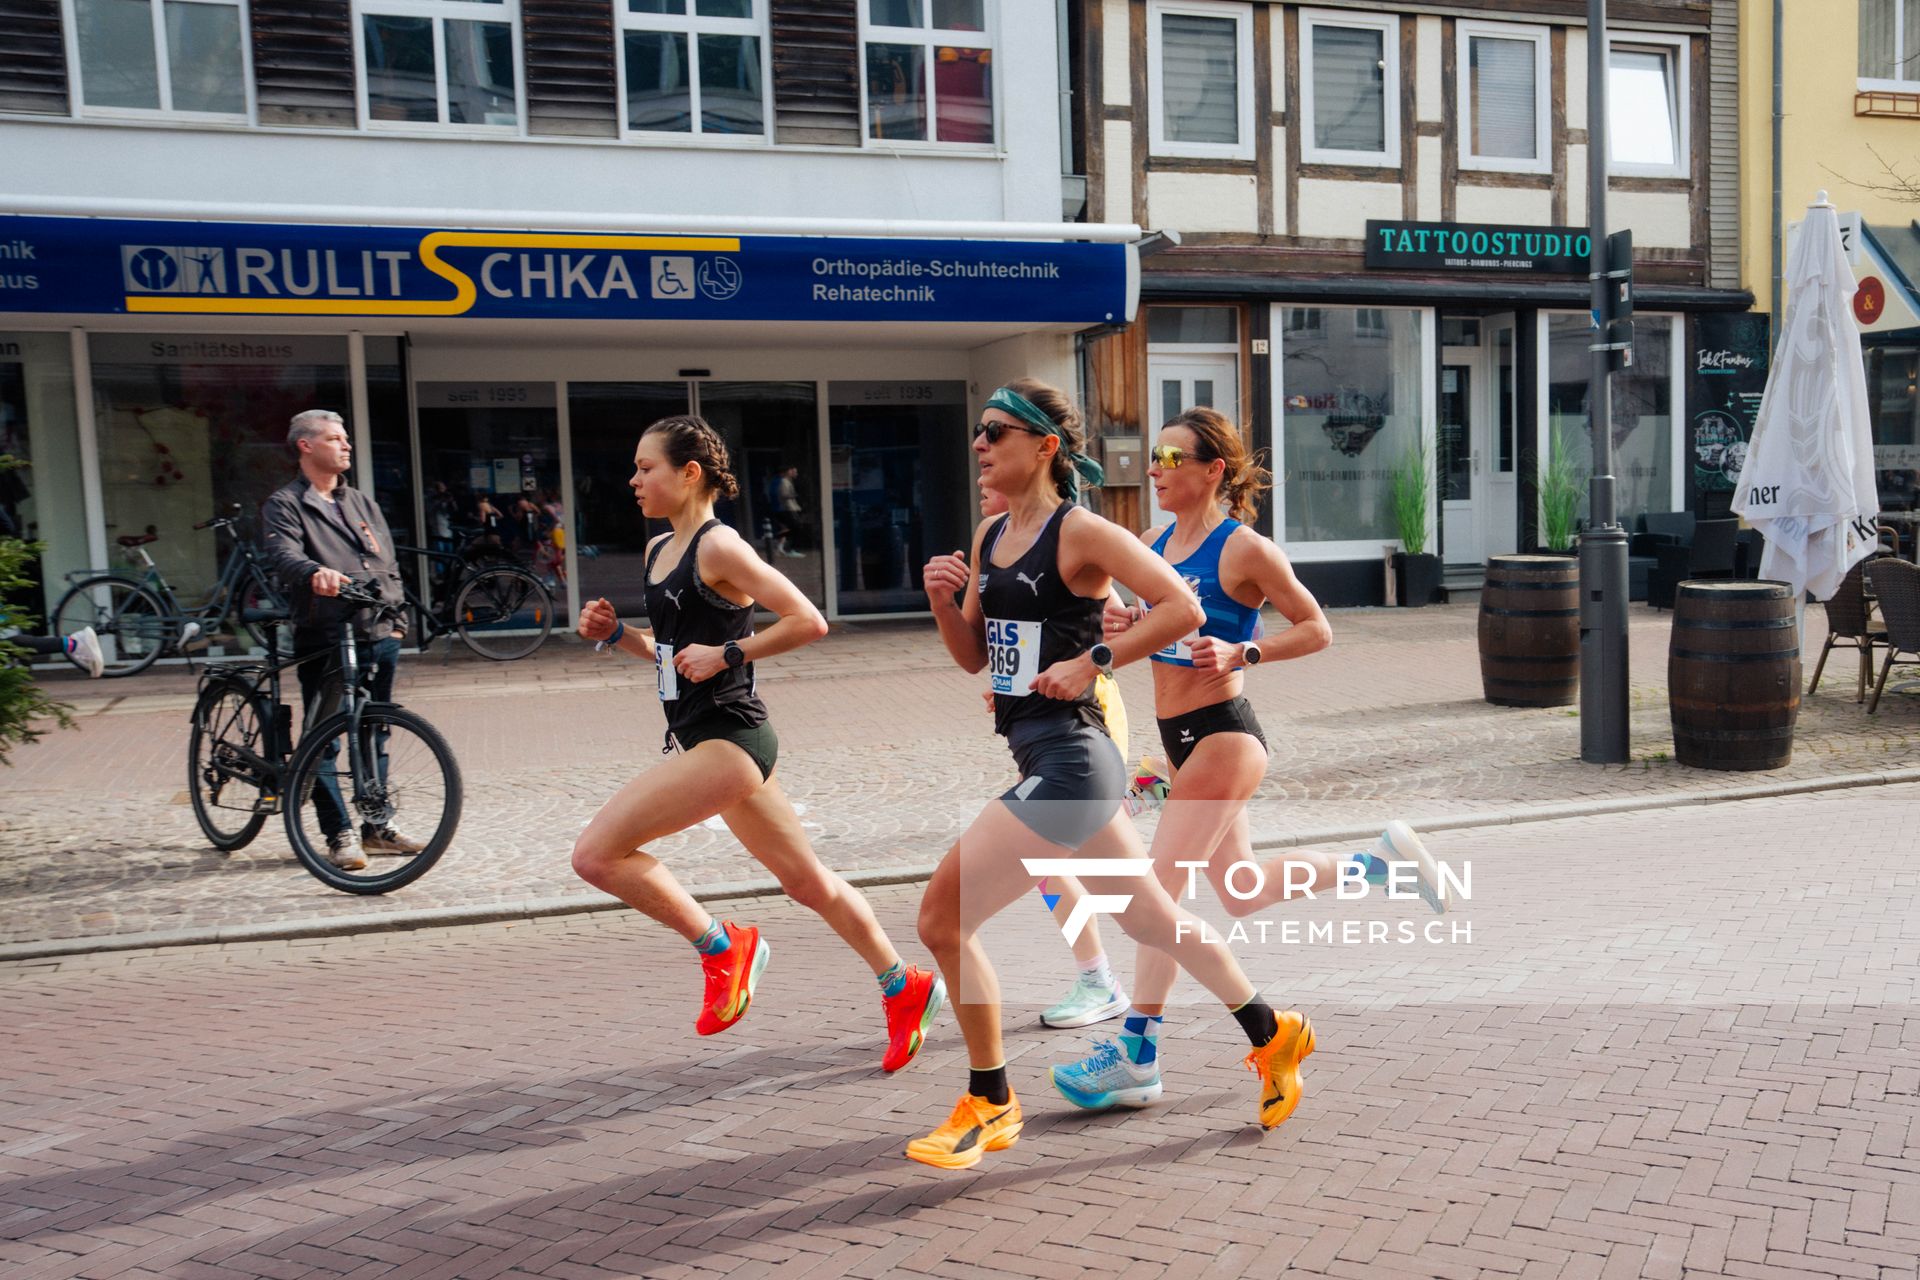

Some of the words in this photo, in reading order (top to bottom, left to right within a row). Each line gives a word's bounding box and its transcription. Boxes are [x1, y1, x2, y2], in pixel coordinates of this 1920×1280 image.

[1379, 227, 1591, 258] TATTOOSTUDIO
[236, 232, 639, 316] RULITSCHKA
[811, 257, 1060, 280] Orthopädie-Schuhtechnik
[812, 283, 935, 302] Rehatechnik
[150, 340, 293, 358] Sanitätshaus
[987, 620, 1019, 647] GLS
[988, 645, 1020, 676] 369
